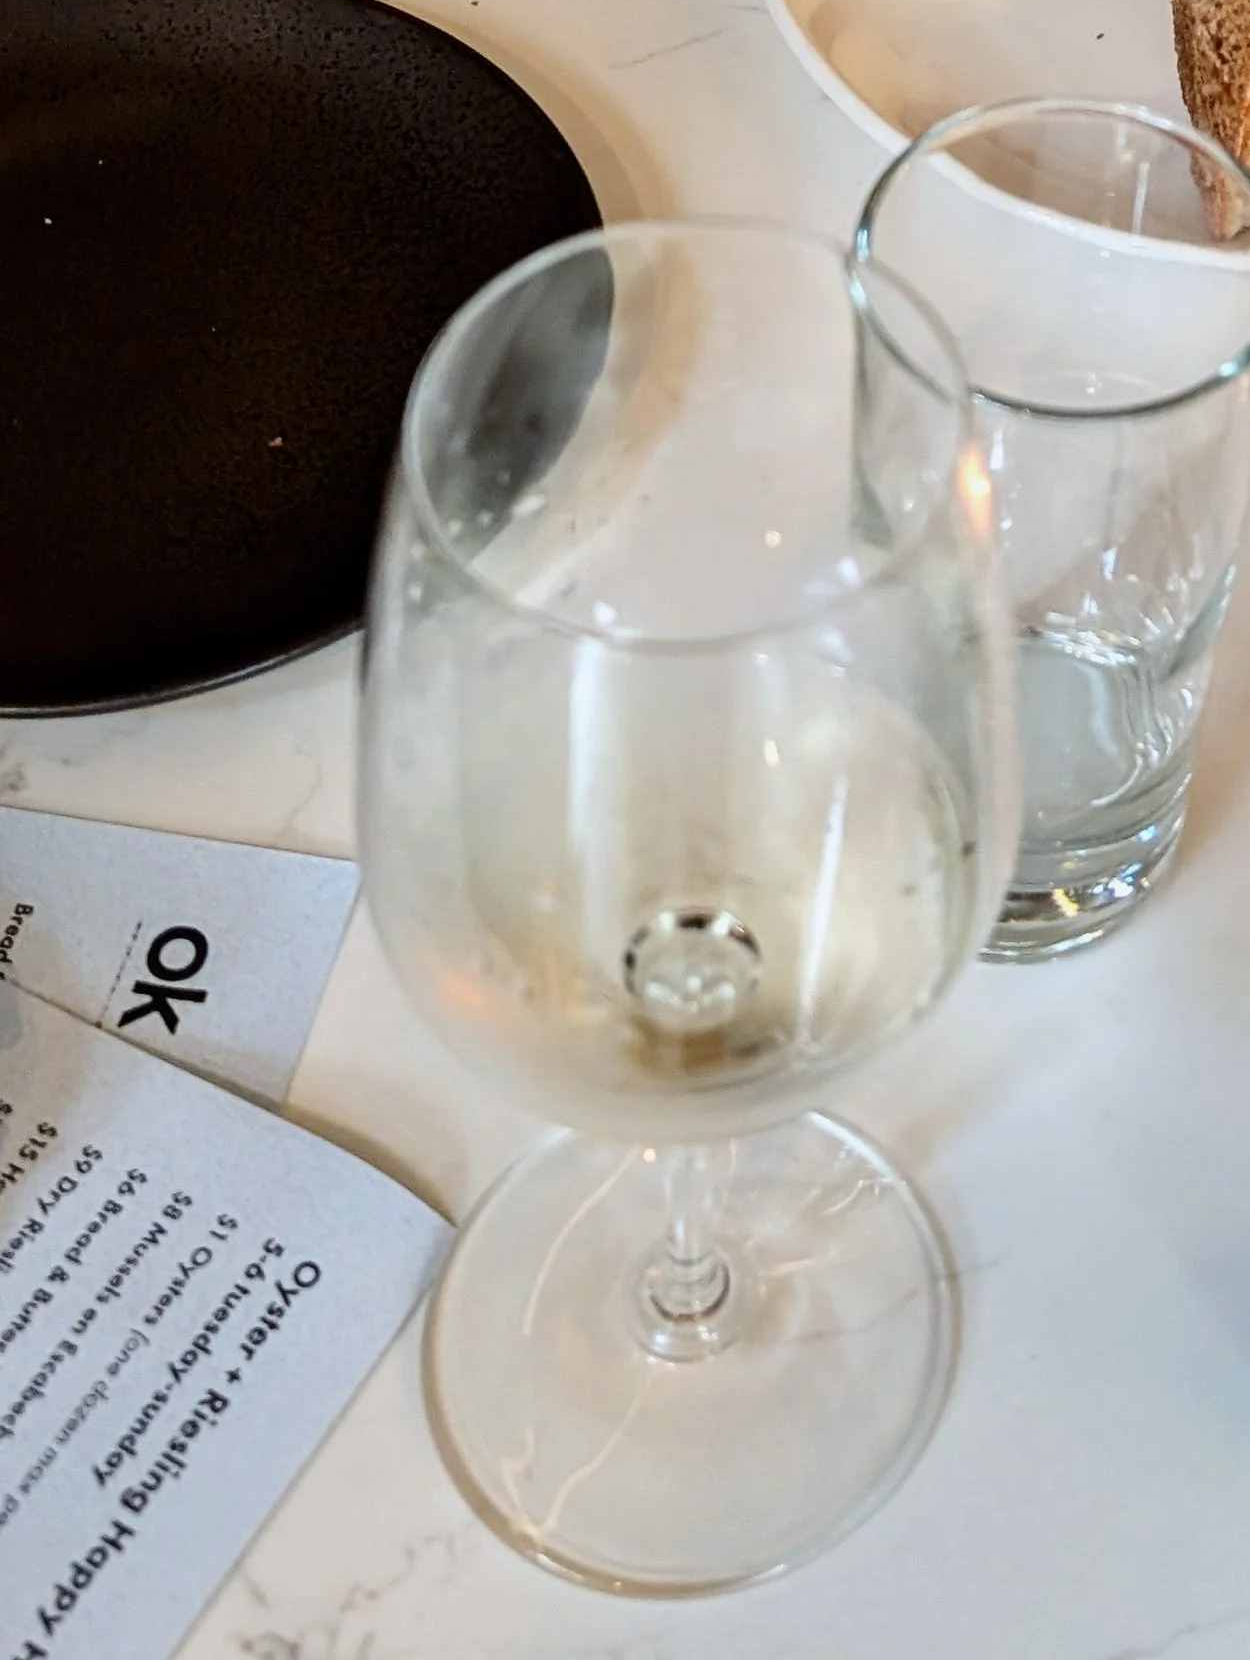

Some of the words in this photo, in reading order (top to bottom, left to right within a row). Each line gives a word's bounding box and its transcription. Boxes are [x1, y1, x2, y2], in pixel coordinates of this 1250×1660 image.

[0, 902, 34, 964] Bread
[18, 1121, 58, 1162] $15
[75, 1145, 102, 1174] $9
[37, 1176, 78, 1215] Dry
[118, 1169, 147, 1195] $6
[162, 1192, 192, 1220] $8
[209, 1214, 238, 1240] $1
[64, 1200, 123, 1265] Bread
[48, 1266, 69, 1282] &
[96, 1222, 167, 1303] Mussels
[245, 1239, 284, 1280] 5-6
[145, 1247, 212, 1325] Oysters
[73, 1308, 97, 1334] en
[241, 1262, 320, 1360] Oyster
[106, 1329, 150, 1377] (one
[94, 1285, 249, 1485] tuesday-sunday
[226, 1368, 241, 1383] +
[55, 1381, 108, 1445] dozen
[121, 1390, 228, 1513] Riesling
[38, 1521, 134, 1635] Happy
